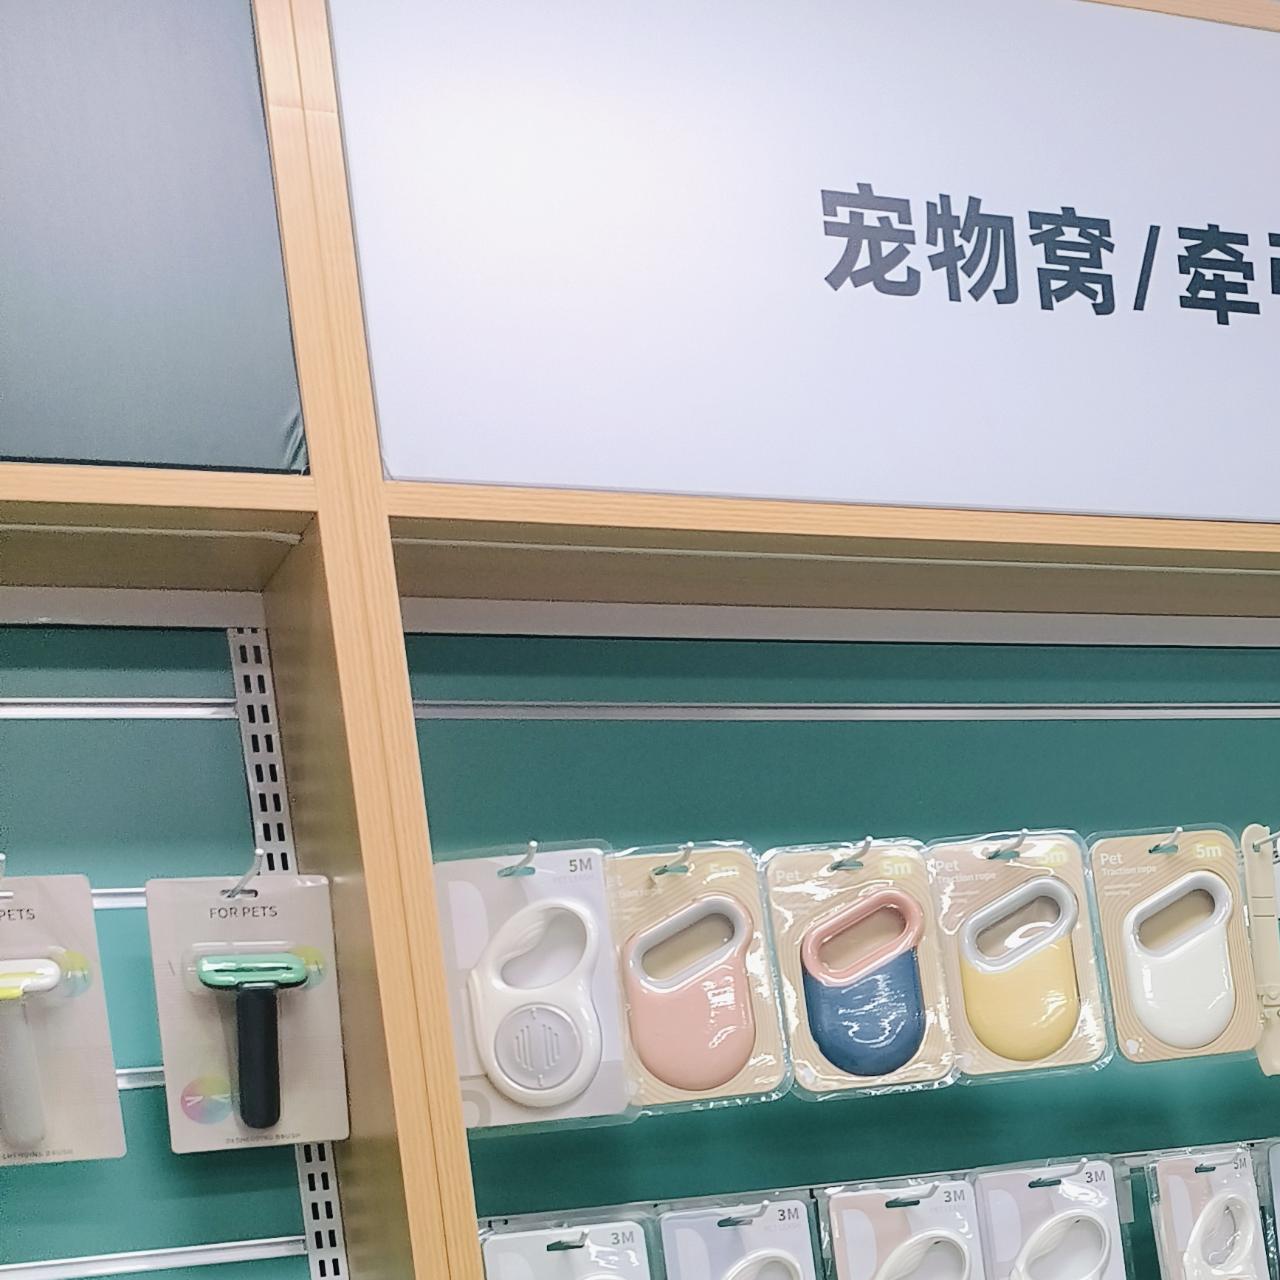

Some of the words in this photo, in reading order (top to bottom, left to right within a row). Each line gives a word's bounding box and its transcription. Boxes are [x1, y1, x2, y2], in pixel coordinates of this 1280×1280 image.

[1195, 844, 1222, 859] 5m
[569, 858, 592, 872] 5M
[936, 860, 960, 872] Pet
[1100, 853, 1123, 866] Pet
[774, 869, 800, 881] Pet
[883, 861, 912, 875] 5m
[209, 906, 239, 919] FOR
[242, 905, 279, 918] PETS
[1085, 1170, 1107, 1184] 3M
[944, 1189, 966, 1203] 3M
[778, 1207, 800, 1221] 3M
[611, 1231, 635, 1245] 3M
